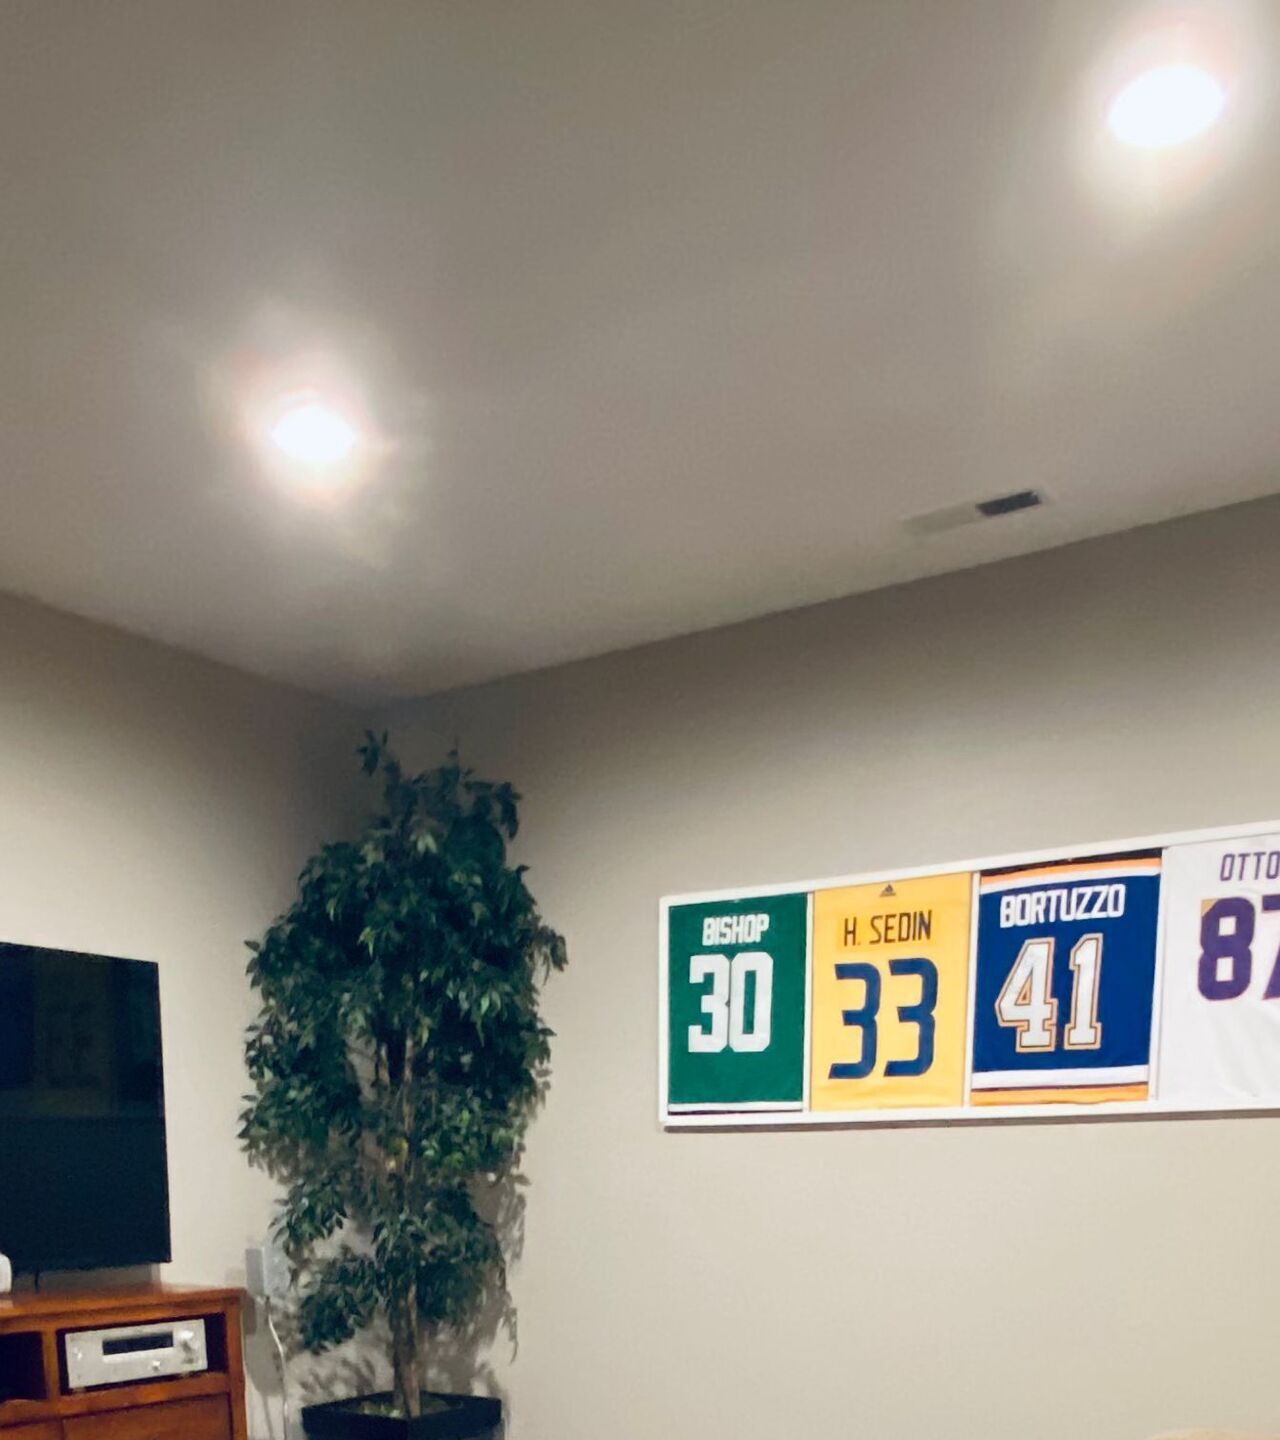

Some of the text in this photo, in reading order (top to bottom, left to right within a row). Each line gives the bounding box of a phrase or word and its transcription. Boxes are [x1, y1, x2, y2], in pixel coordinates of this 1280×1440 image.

[702, 913, 769, 946] BISHOP
[843, 909, 932, 947] H. SEDIN
[999, 883, 1126, 928] BORTUZZO
[688, 951, 774, 1053] 30
[828, 957, 939, 1079] 33
[995, 932, 1104, 1053] 41
